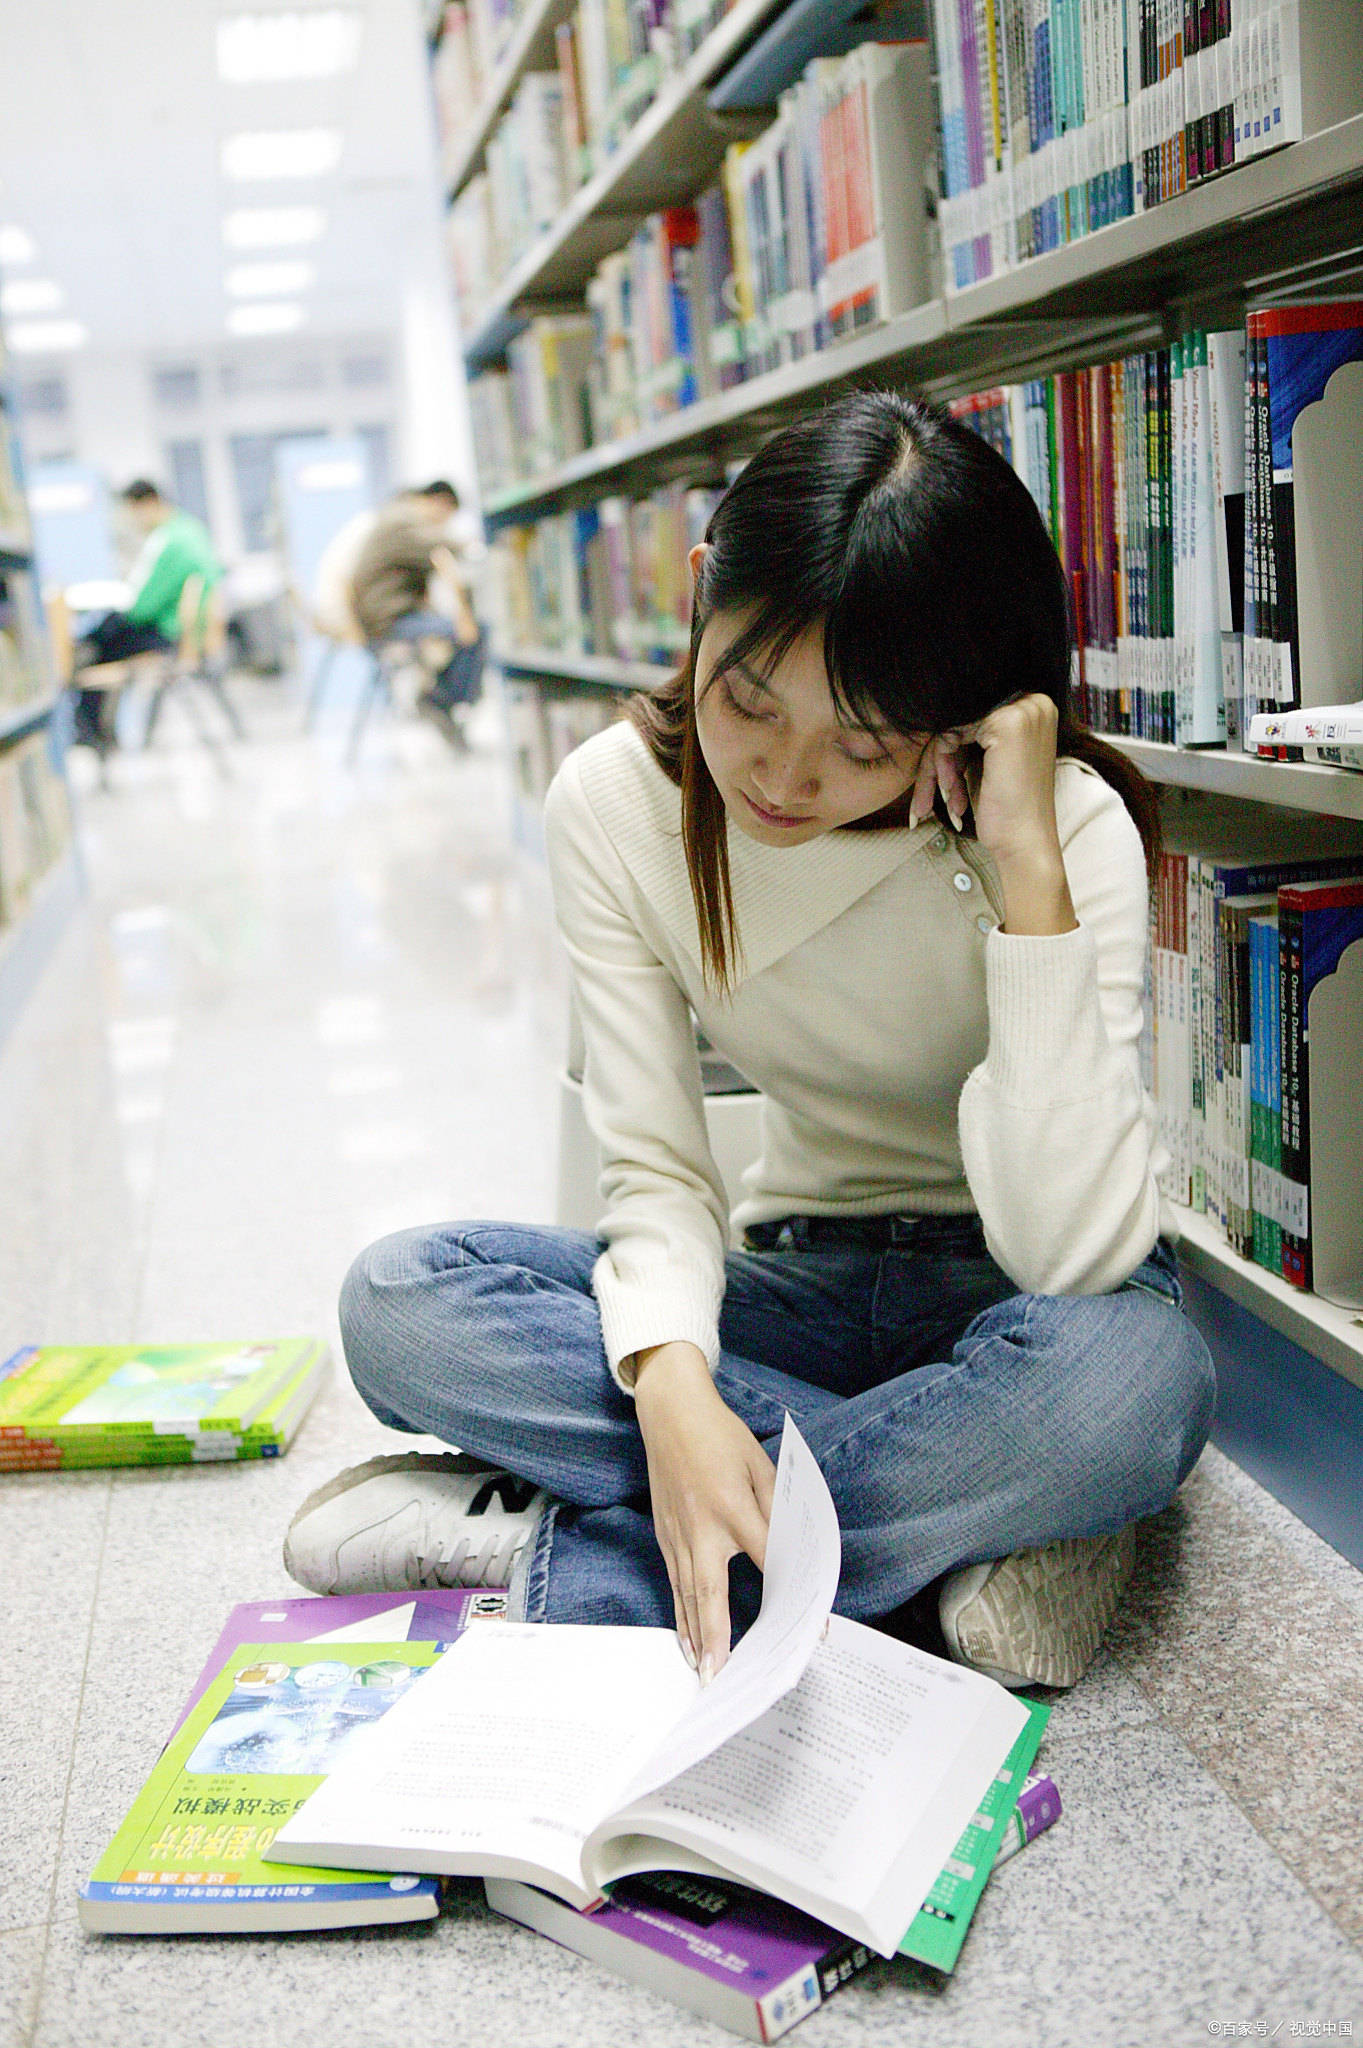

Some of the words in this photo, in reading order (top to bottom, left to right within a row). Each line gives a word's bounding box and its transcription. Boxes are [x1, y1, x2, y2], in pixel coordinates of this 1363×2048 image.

[1261, 406, 1270, 451] Oracle
[1263, 455, 1273, 520] Database
[1291, 974, 1299, 1014] Oracle
[1291, 1016, 1299, 1073] Database
[149, 1823, 281, 1861] o程序设计
